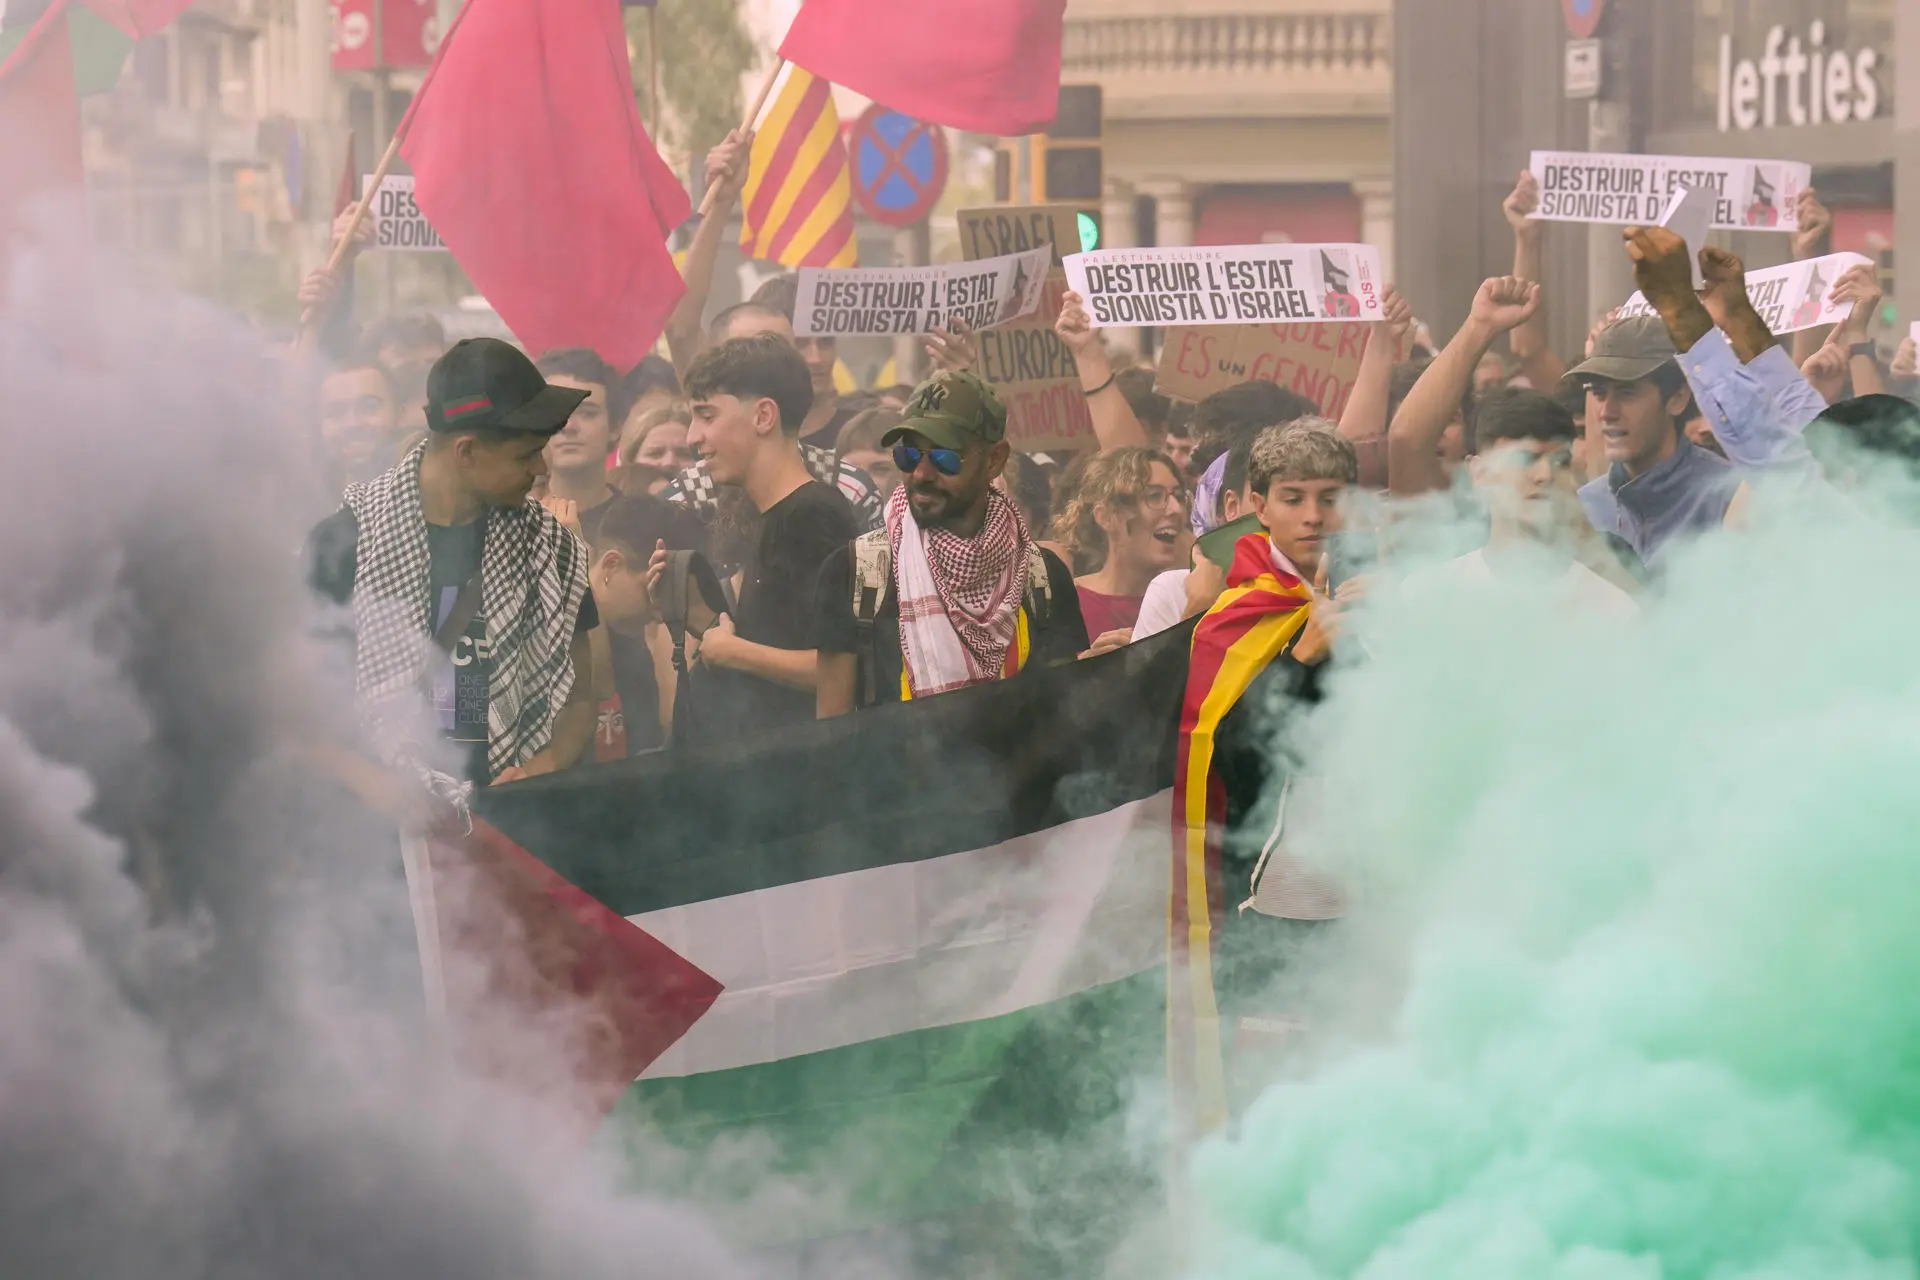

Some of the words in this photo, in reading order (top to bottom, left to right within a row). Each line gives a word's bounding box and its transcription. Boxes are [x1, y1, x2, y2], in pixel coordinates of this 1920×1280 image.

[1718, 19, 1877, 132] lefties
[1544, 165, 1644, 194] DESTRUIR
[1542, 192, 1638, 220] SIONISTA
[378, 219, 447, 247] SIONI
[1082, 254, 1162, 264] PALESTINA
[813, 281, 925, 309] DESTRUIR
[930, 271, 999, 308] L'ESTAT
[1085, 262, 1203, 294] DESTRUIR
[1205, 259, 1294, 291] L'ESTAT
[810, 308, 918, 334] SIONISTA
[1092, 292, 1207, 322] SIONISTA
[1209, 289, 1315, 320] D'ISRAEL
[980, 328, 1080, 384] EUROPA
[1177, 330, 1217, 380] ES
[1218, 358, 1246, 376] UN
[459, 699, 483, 711] ONE
